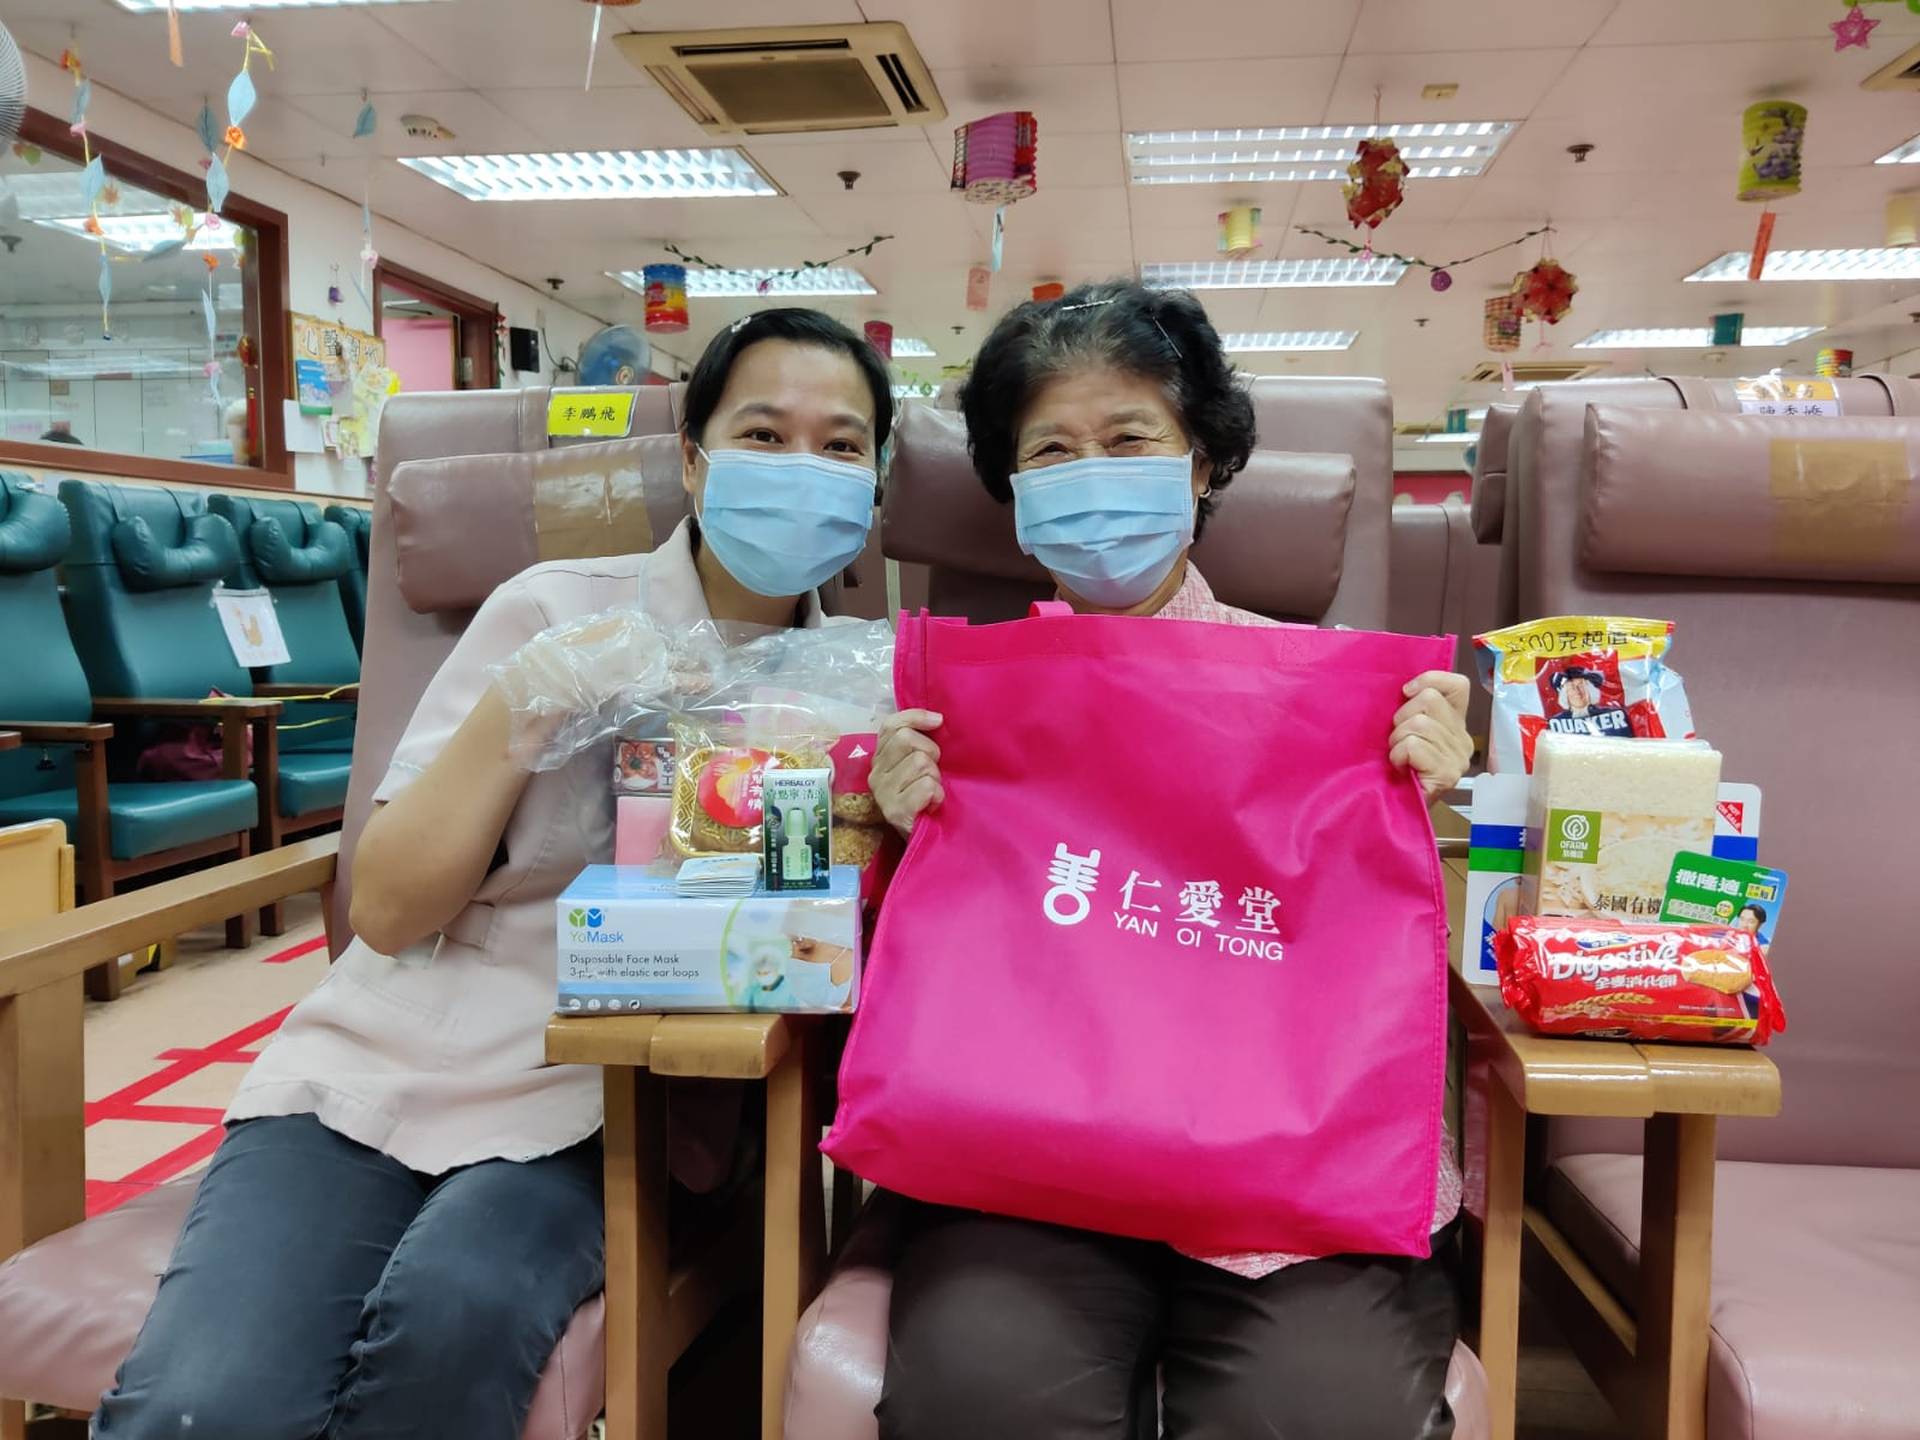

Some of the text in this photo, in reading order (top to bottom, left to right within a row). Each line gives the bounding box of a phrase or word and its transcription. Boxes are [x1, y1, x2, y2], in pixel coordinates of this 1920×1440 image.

[563, 406, 615, 421] 李鵬飛
[1549, 710, 1627, 735] QUAKER
[1120, 870, 1282, 934] 仁愛堂
[570, 931, 625, 943] YoMask
[1113, 912, 1284, 961] YAN OI TONG
[570, 954, 680, 967] Disposable Face Mask
[1551, 942, 1678, 980] Digestive
[597, 967, 617, 977] with
[620, 967, 650, 977] elastic
[653, 969, 670, 977] ear
[672, 966, 700, 980] loops
